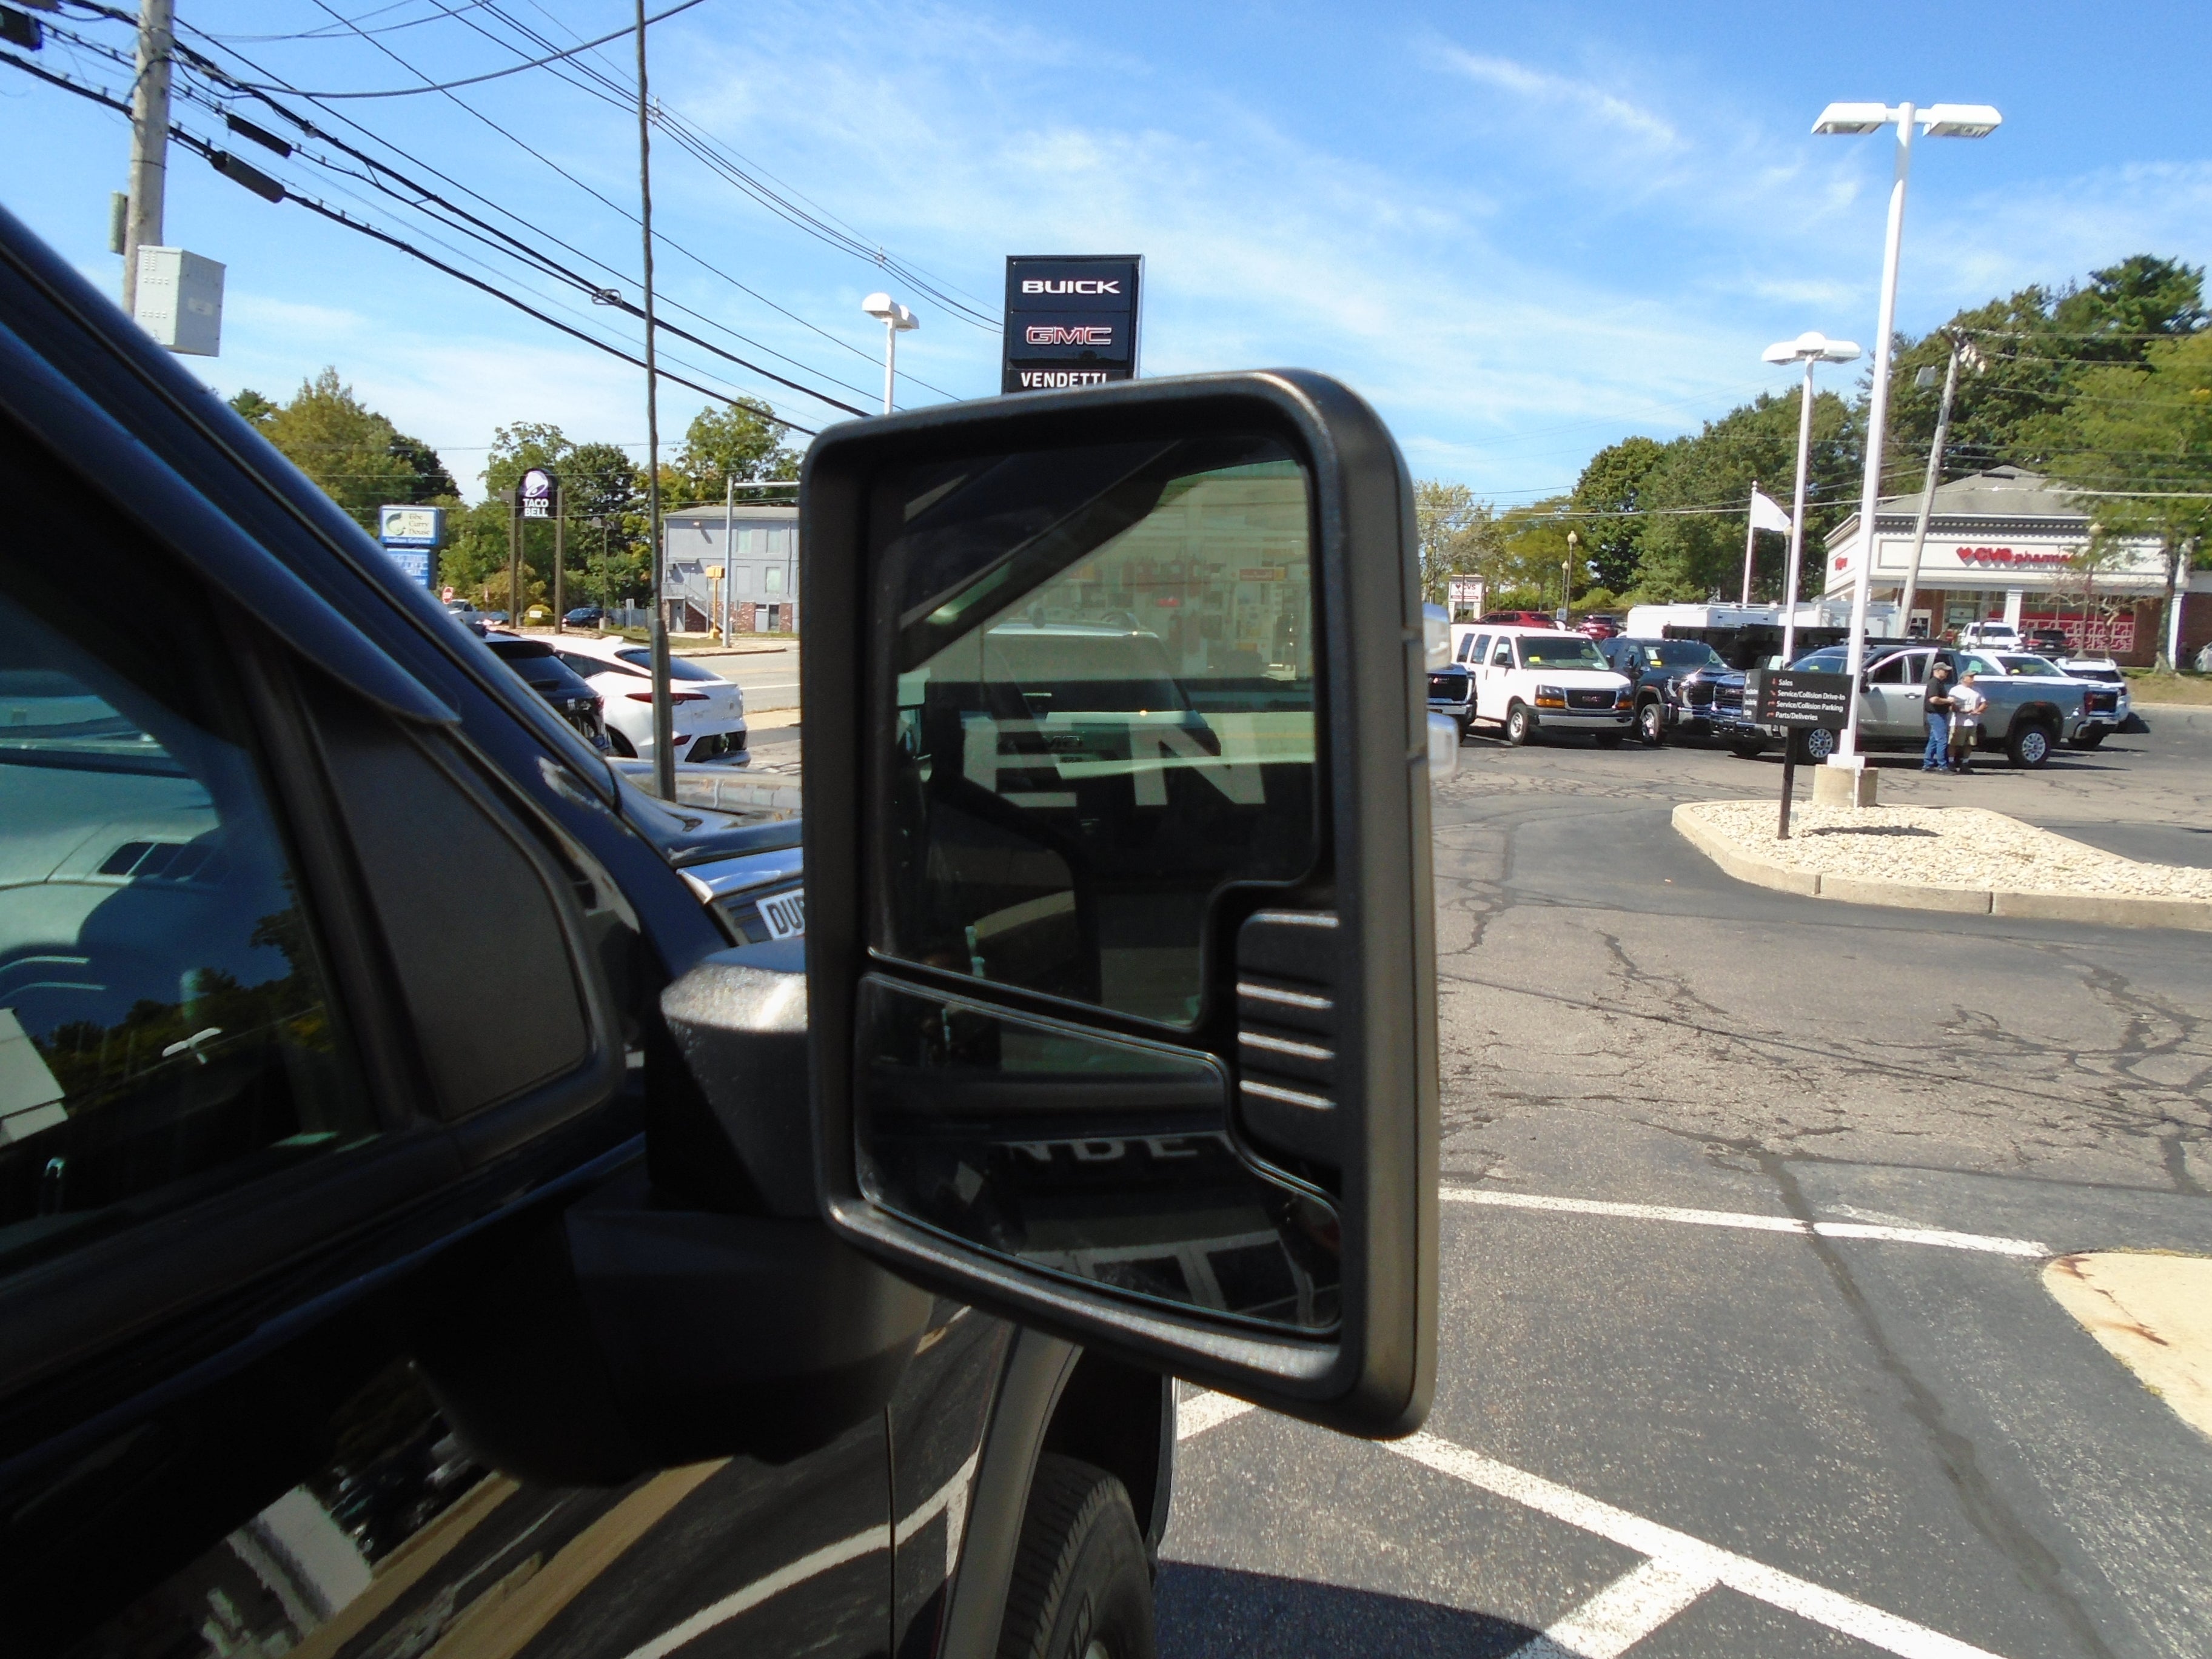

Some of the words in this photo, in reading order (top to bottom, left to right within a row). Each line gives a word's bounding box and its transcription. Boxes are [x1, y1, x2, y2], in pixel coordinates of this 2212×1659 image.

[1022, 281, 1121, 293] BUICK
[1026, 326, 1112, 344] GMC
[1021, 372, 1107, 387] VENDETTI
[523, 498, 549, 508] TACO
[524, 508, 548, 517] BELL
[1974, 548, 2012, 561] CVS
[1777, 689, 1822, 699] Service/Collision
[1776, 700, 1821, 709] Service/Collision
[1822, 703, 1843, 712] Parking
[1775, 711, 1818, 720] Parts/Deliveries
